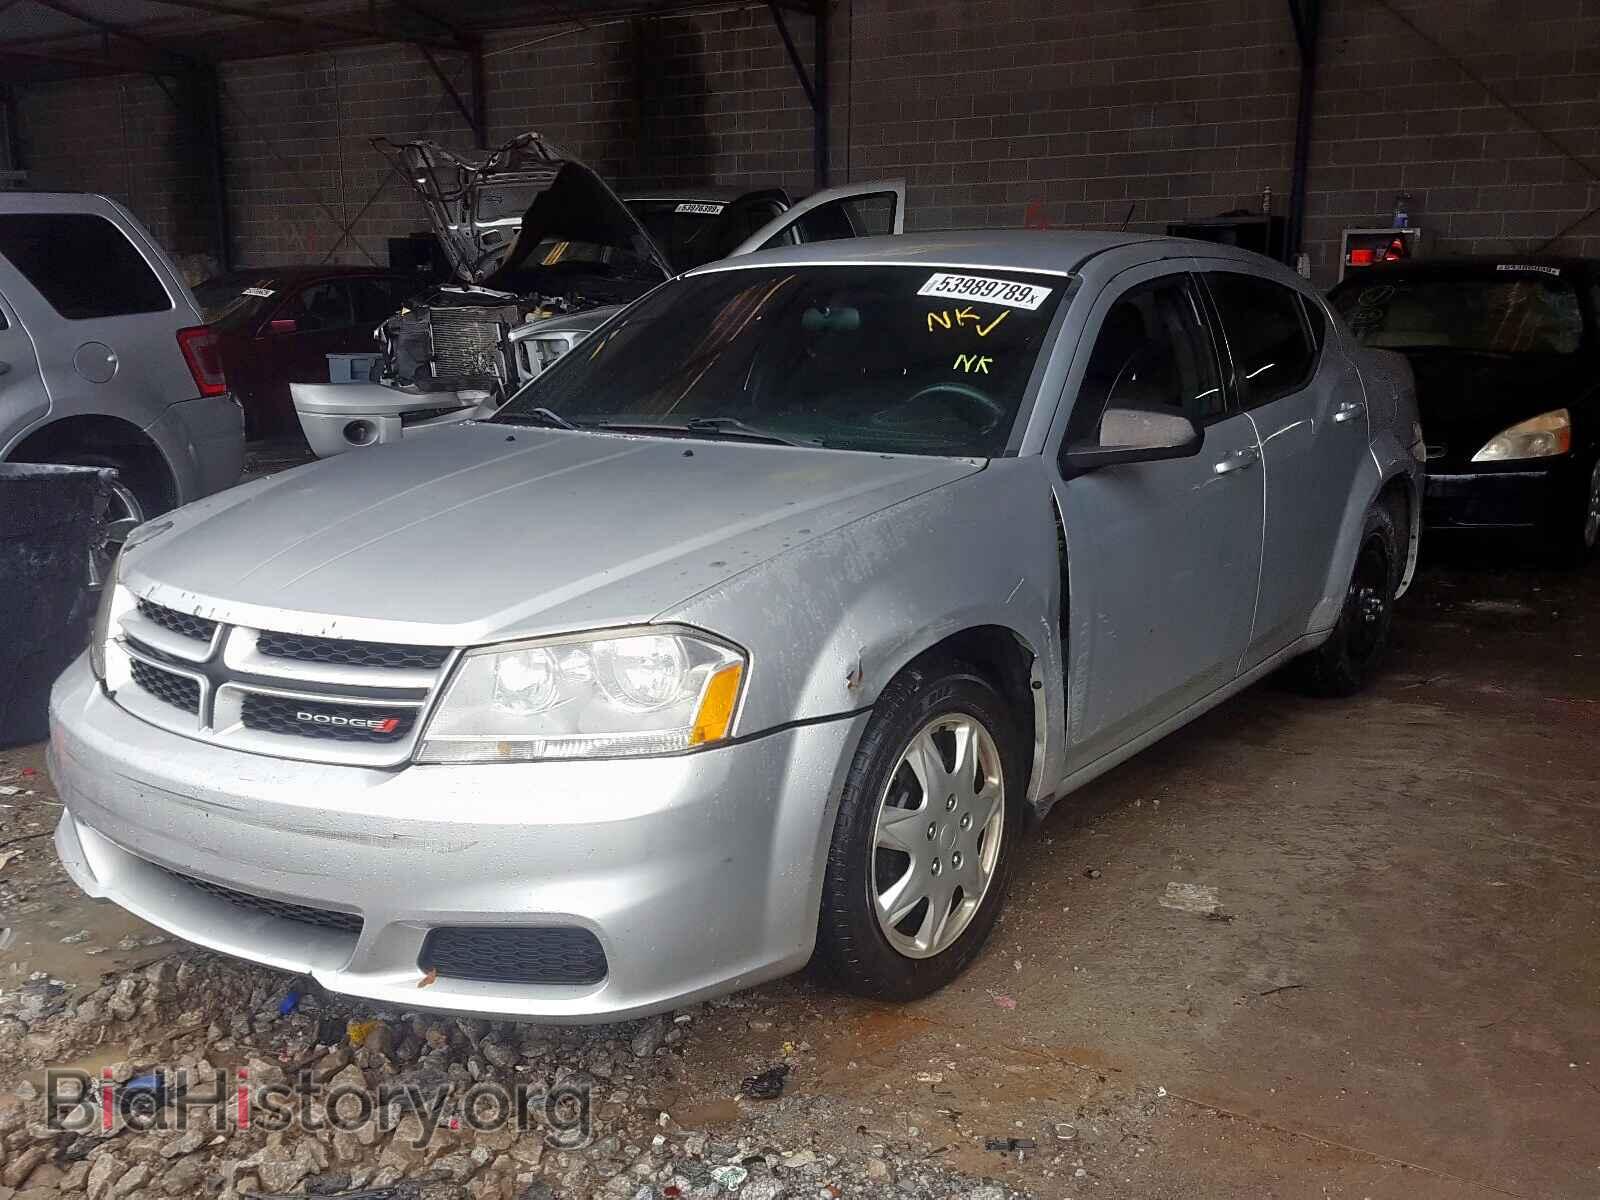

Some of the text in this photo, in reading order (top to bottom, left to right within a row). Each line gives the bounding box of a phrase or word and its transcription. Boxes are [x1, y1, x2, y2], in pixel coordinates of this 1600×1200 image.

[928, 306, 980, 332] NK
[953, 354, 993, 374] NK
[297, 711, 385, 729] DODGE
